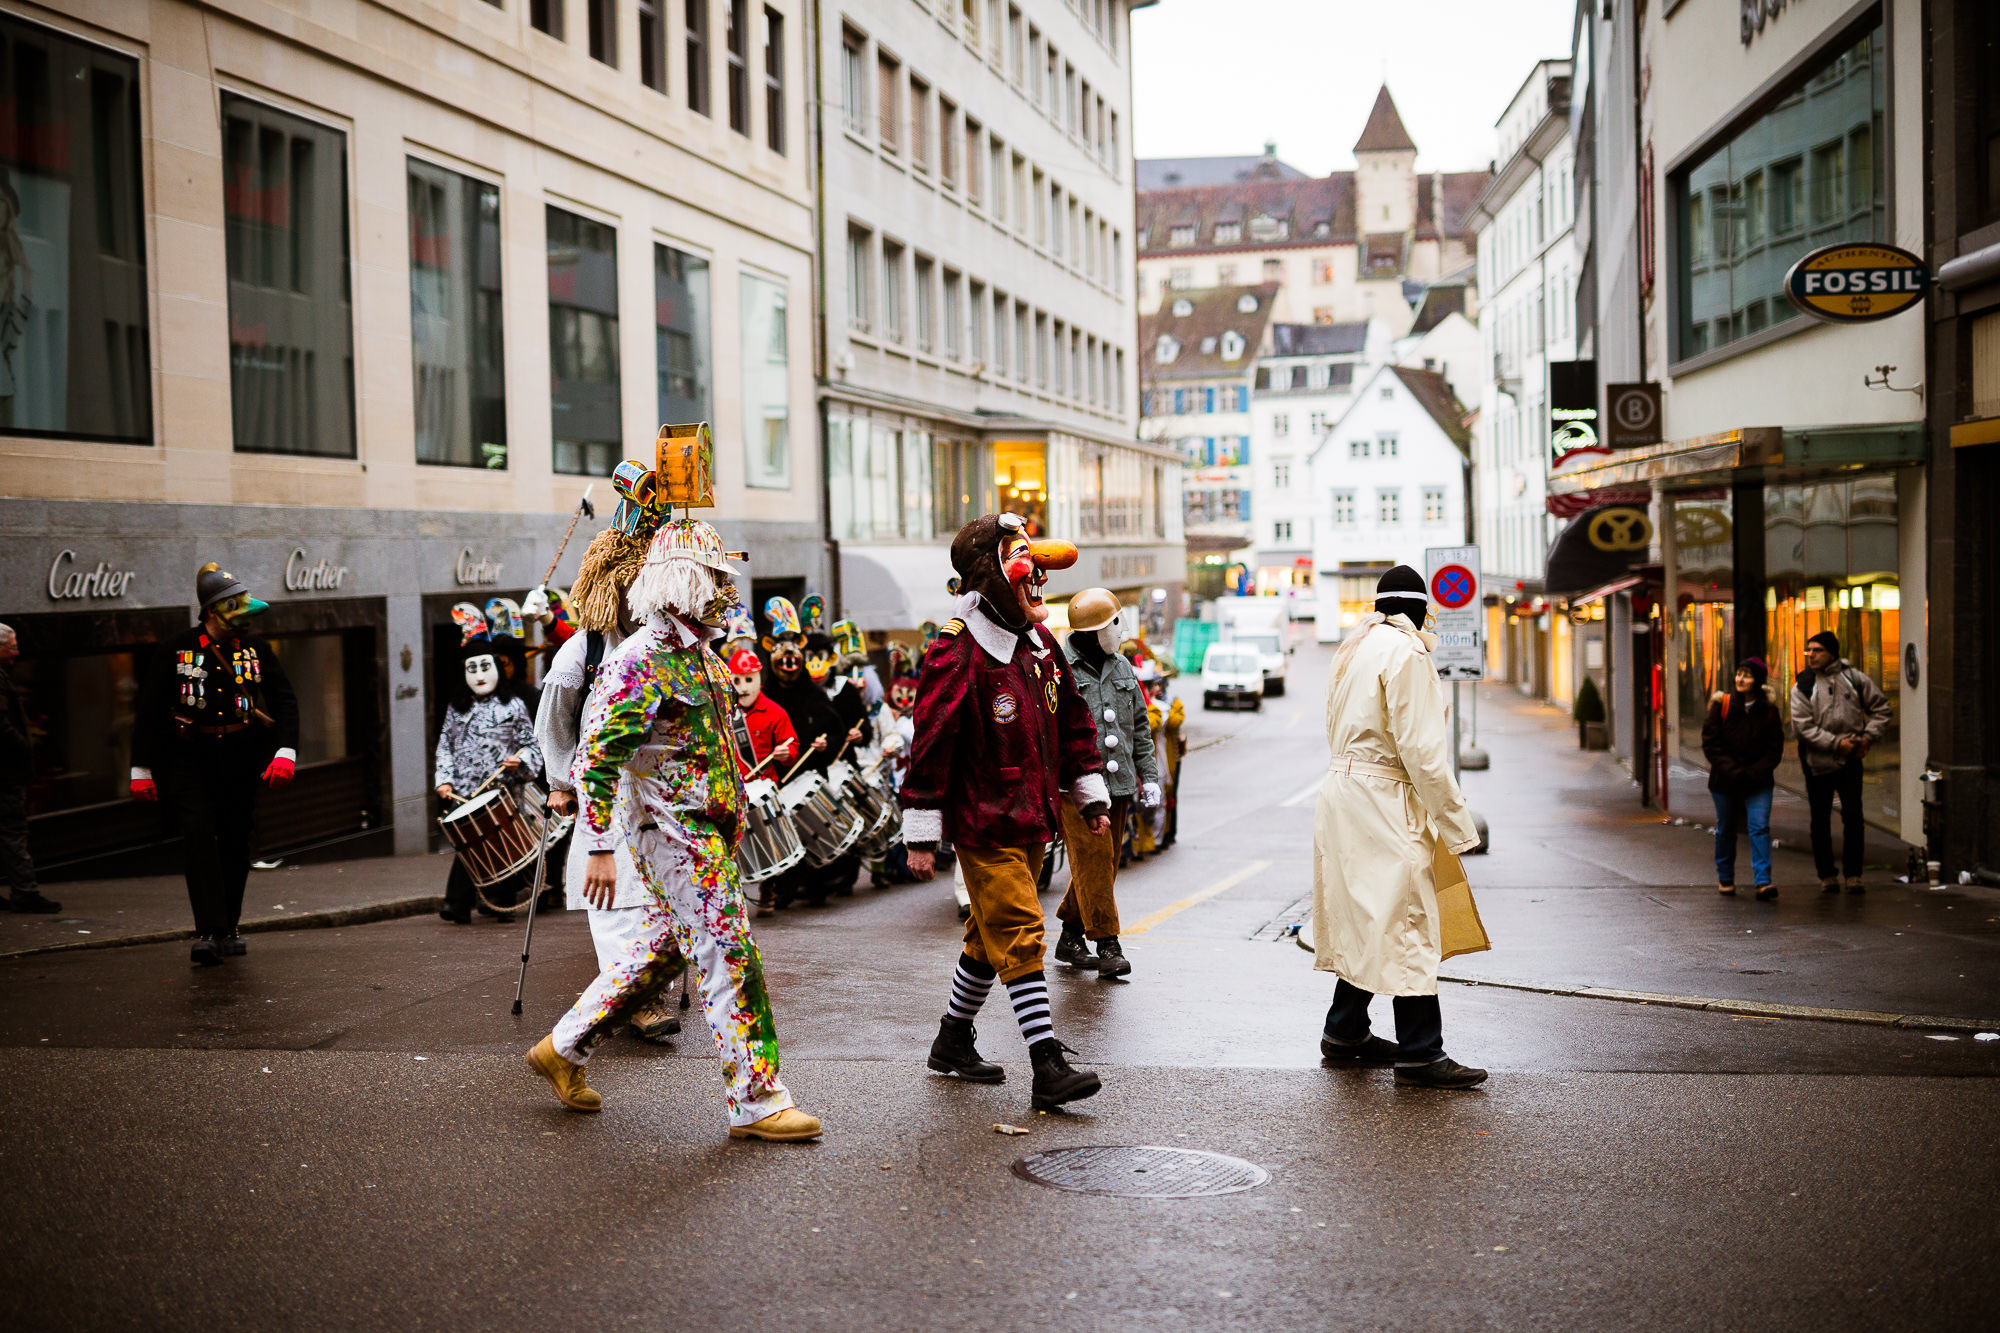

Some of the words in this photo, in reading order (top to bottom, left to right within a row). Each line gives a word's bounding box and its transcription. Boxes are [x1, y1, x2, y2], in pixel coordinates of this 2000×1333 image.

[1815, 249, 1906, 268] AUTHENTIC
[1804, 270, 1921, 294] FOSSIL
[49, 549, 135, 599] Cartier
[284, 547, 348, 592] Cartier
[456, 546, 504, 585] Cartier
